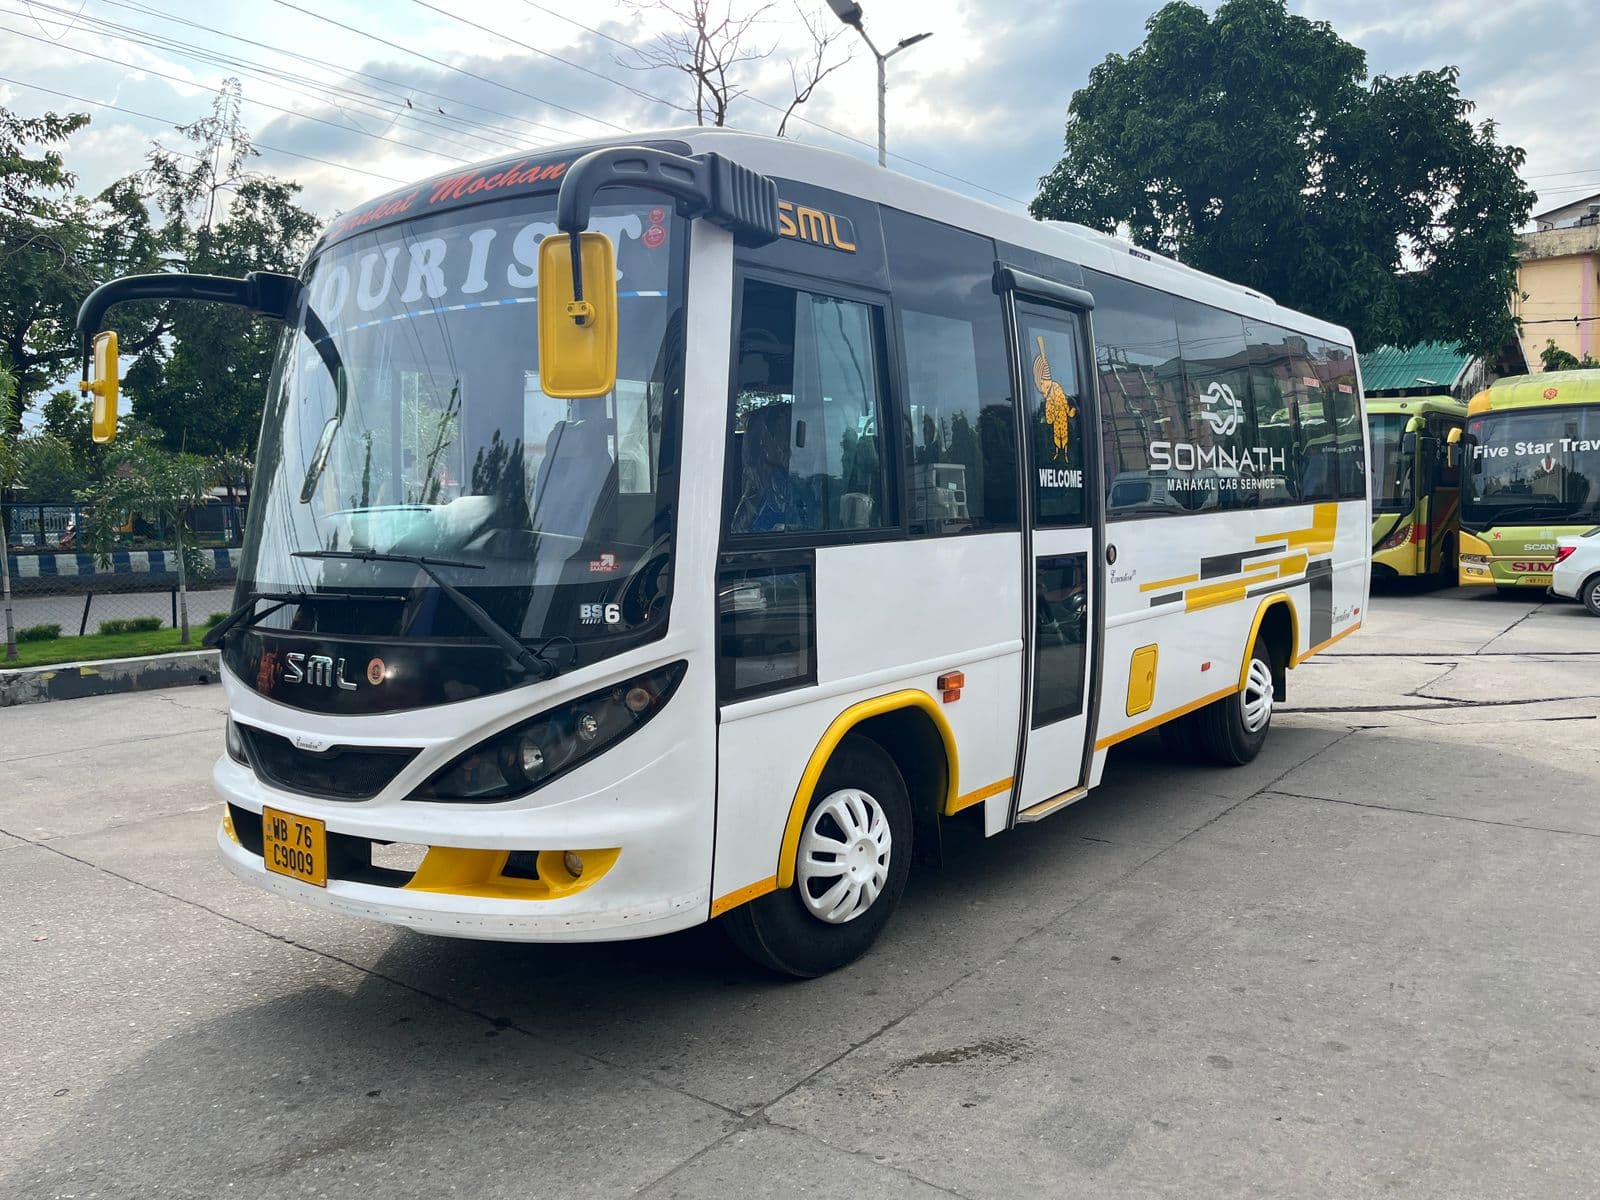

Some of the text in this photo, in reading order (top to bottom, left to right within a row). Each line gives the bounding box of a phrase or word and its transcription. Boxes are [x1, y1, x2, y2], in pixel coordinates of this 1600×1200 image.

[429, 160, 568, 205] Mochan
[778, 201, 856, 252] SML
[1149, 441, 1286, 472] SOMNATH
[1473, 445, 1509, 459] Five
[1514, 442, 1554, 456] Star
[1039, 468, 1083, 488] WELCOME
[1167, 478, 1276, 491] MAHAKAL CAB SERVICE
[284, 652, 358, 691] SML
[272, 816, 312, 849] WB 76
[273, 843, 314, 876] C9009
